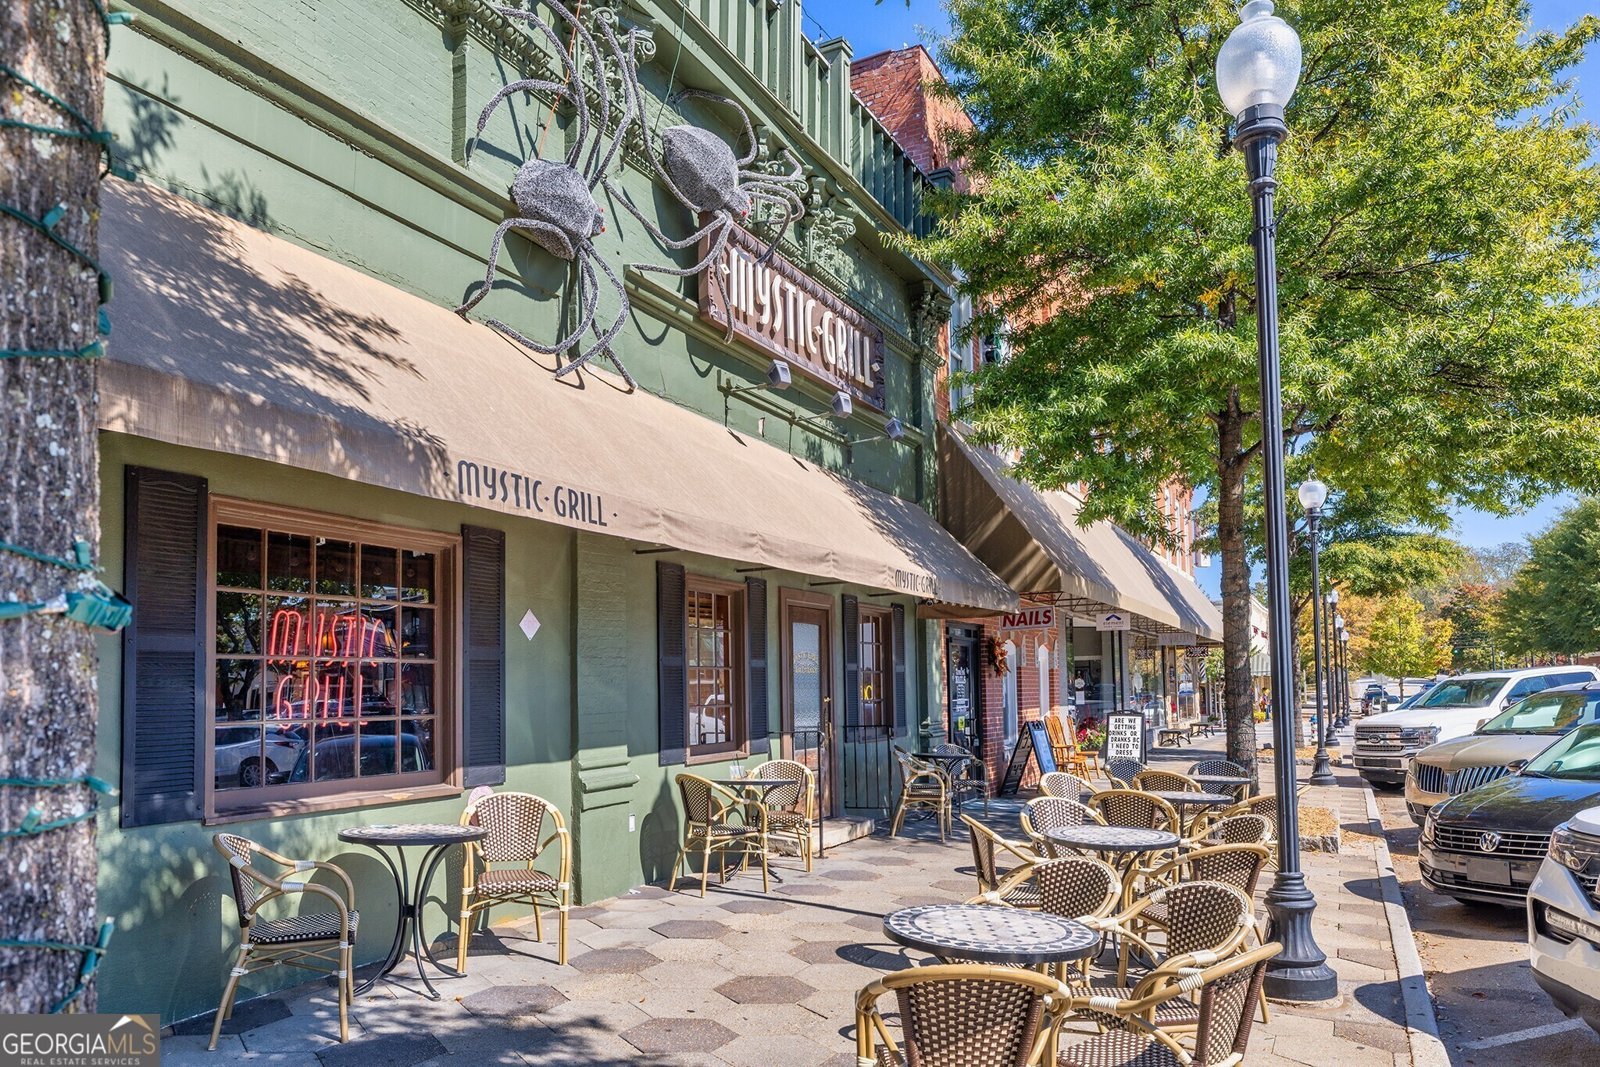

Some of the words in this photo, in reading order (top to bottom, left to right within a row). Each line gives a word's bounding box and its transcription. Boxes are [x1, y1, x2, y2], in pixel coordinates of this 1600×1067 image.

[730, 248, 817, 354] MYSTIC
[822, 310, 874, 388] GRILL
[457, 460, 544, 513] MYSTIC
[553, 485, 608, 527] GRILL
[895, 569, 919, 592] MYSTIC
[268, 609, 383, 667] MYSTIC
[1003, 610, 1052, 628] NAILS
[275, 674, 368, 730] GRILL
